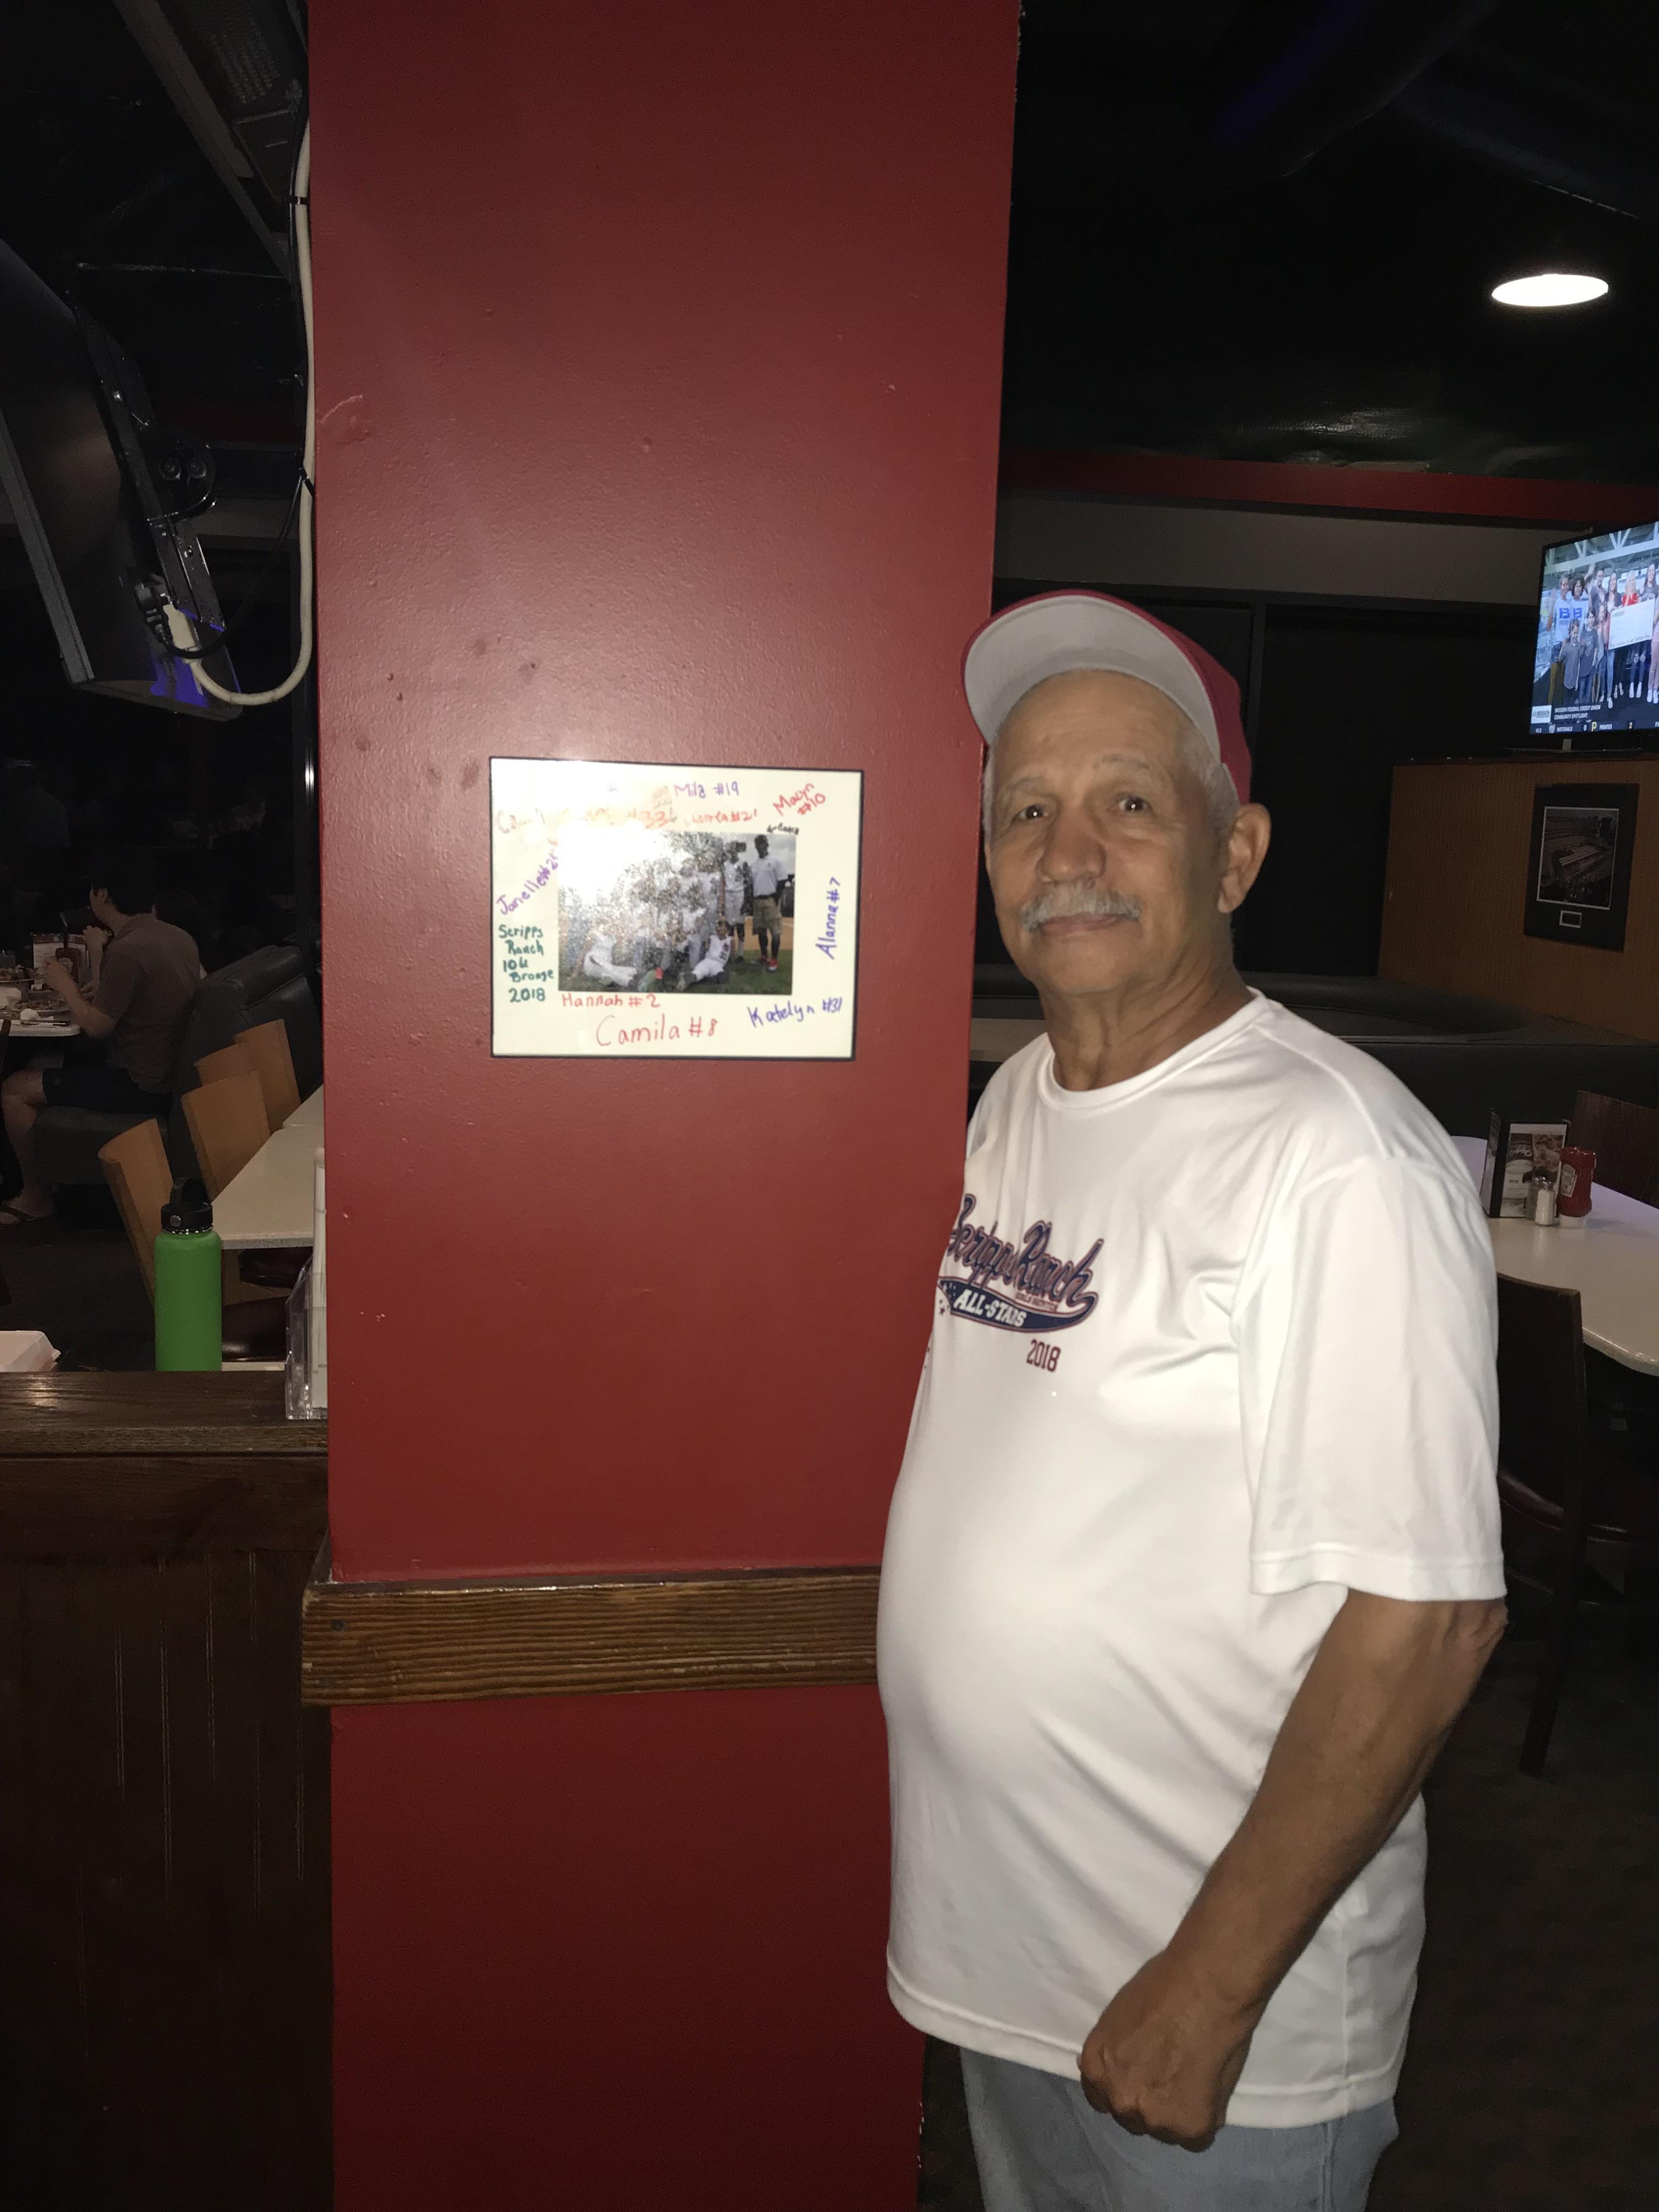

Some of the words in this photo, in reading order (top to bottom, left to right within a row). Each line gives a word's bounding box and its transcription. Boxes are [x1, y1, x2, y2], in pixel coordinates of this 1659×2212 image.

[674, 781, 707, 799] Mila
[713, 781, 740, 796] #19
[797, 793, 826, 815] #10
[498, 924, 544, 940] Scripps
[505, 939, 545, 956] Ranch
[509, 969, 555, 983] Bronze
[508, 988, 546, 1003] 2018
[562, 992, 623, 1007] Hannah
[747, 1000, 815, 1028] Katelyn
[596, 1013, 680, 1046] Camila
[688, 1015, 718, 1039] #8
[952, 1289, 1028, 1328] ALL-STARS
[1026, 1339, 1062, 1373] 2018
